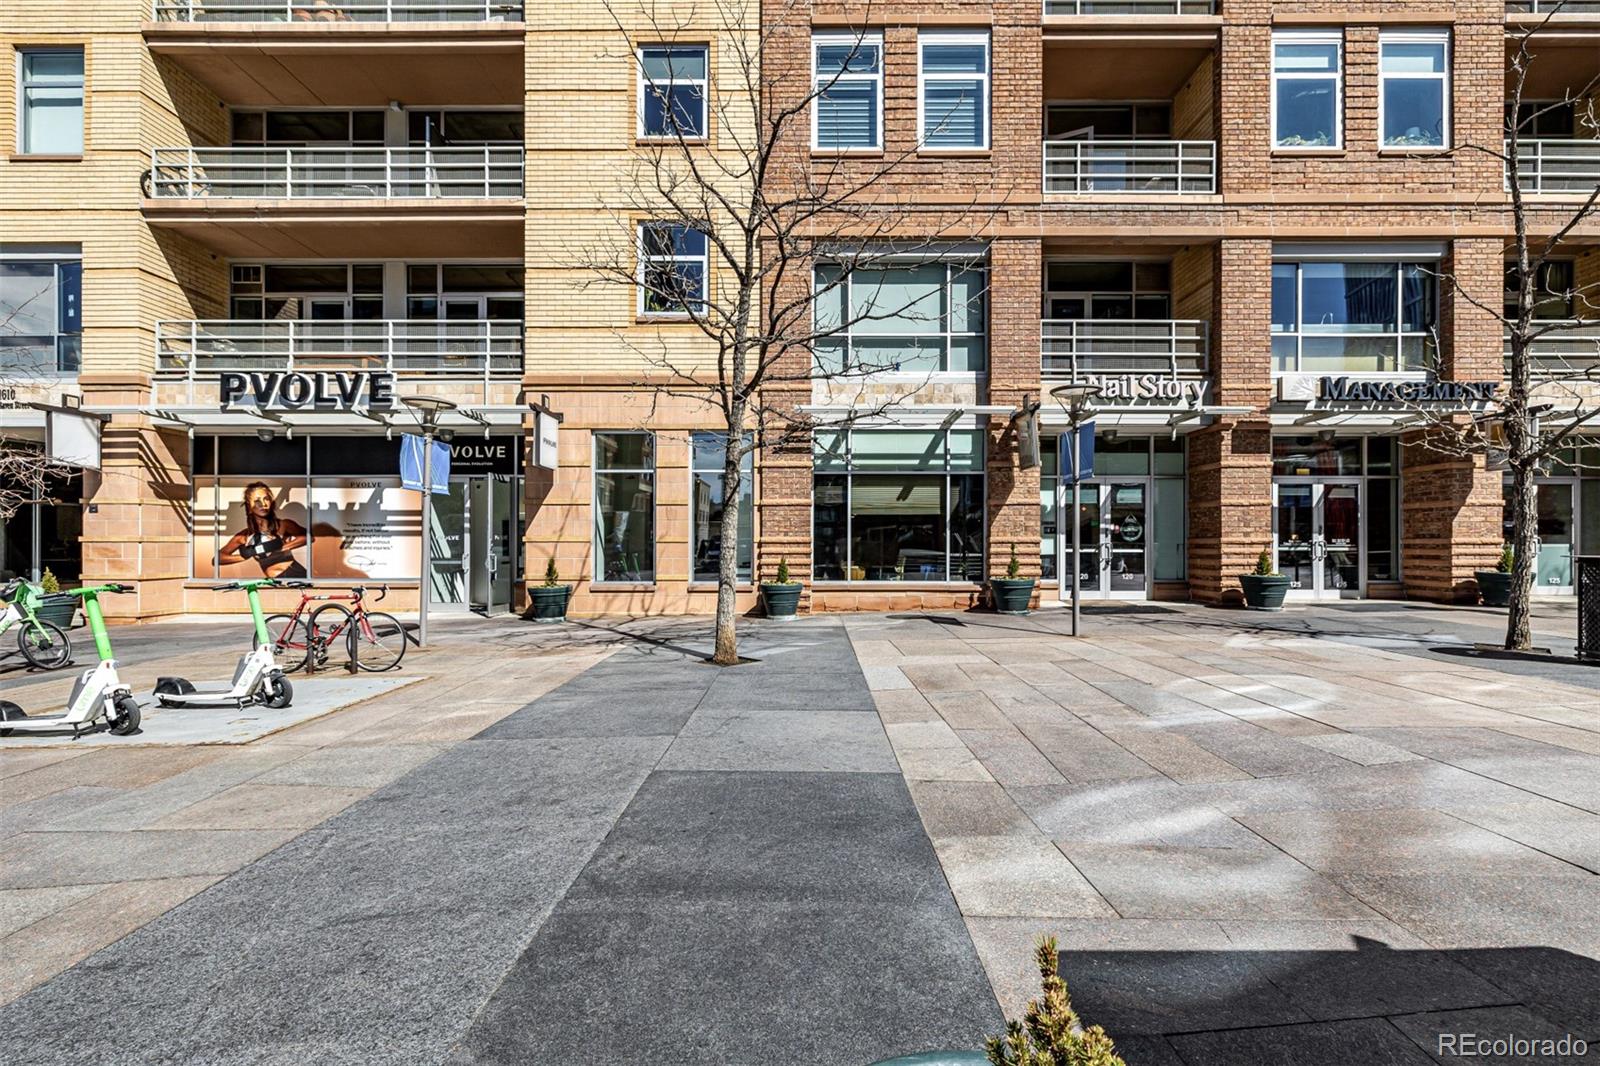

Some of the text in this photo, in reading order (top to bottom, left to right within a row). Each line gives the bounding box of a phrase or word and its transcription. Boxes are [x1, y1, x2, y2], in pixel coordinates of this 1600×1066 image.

[220, 372, 397, 409] PVOLVE
[1085, 373, 1208, 410] Nail Story
[1320, 376, 1499, 401] MANAGEMENT
[450, 445, 506, 458] VOLVE
